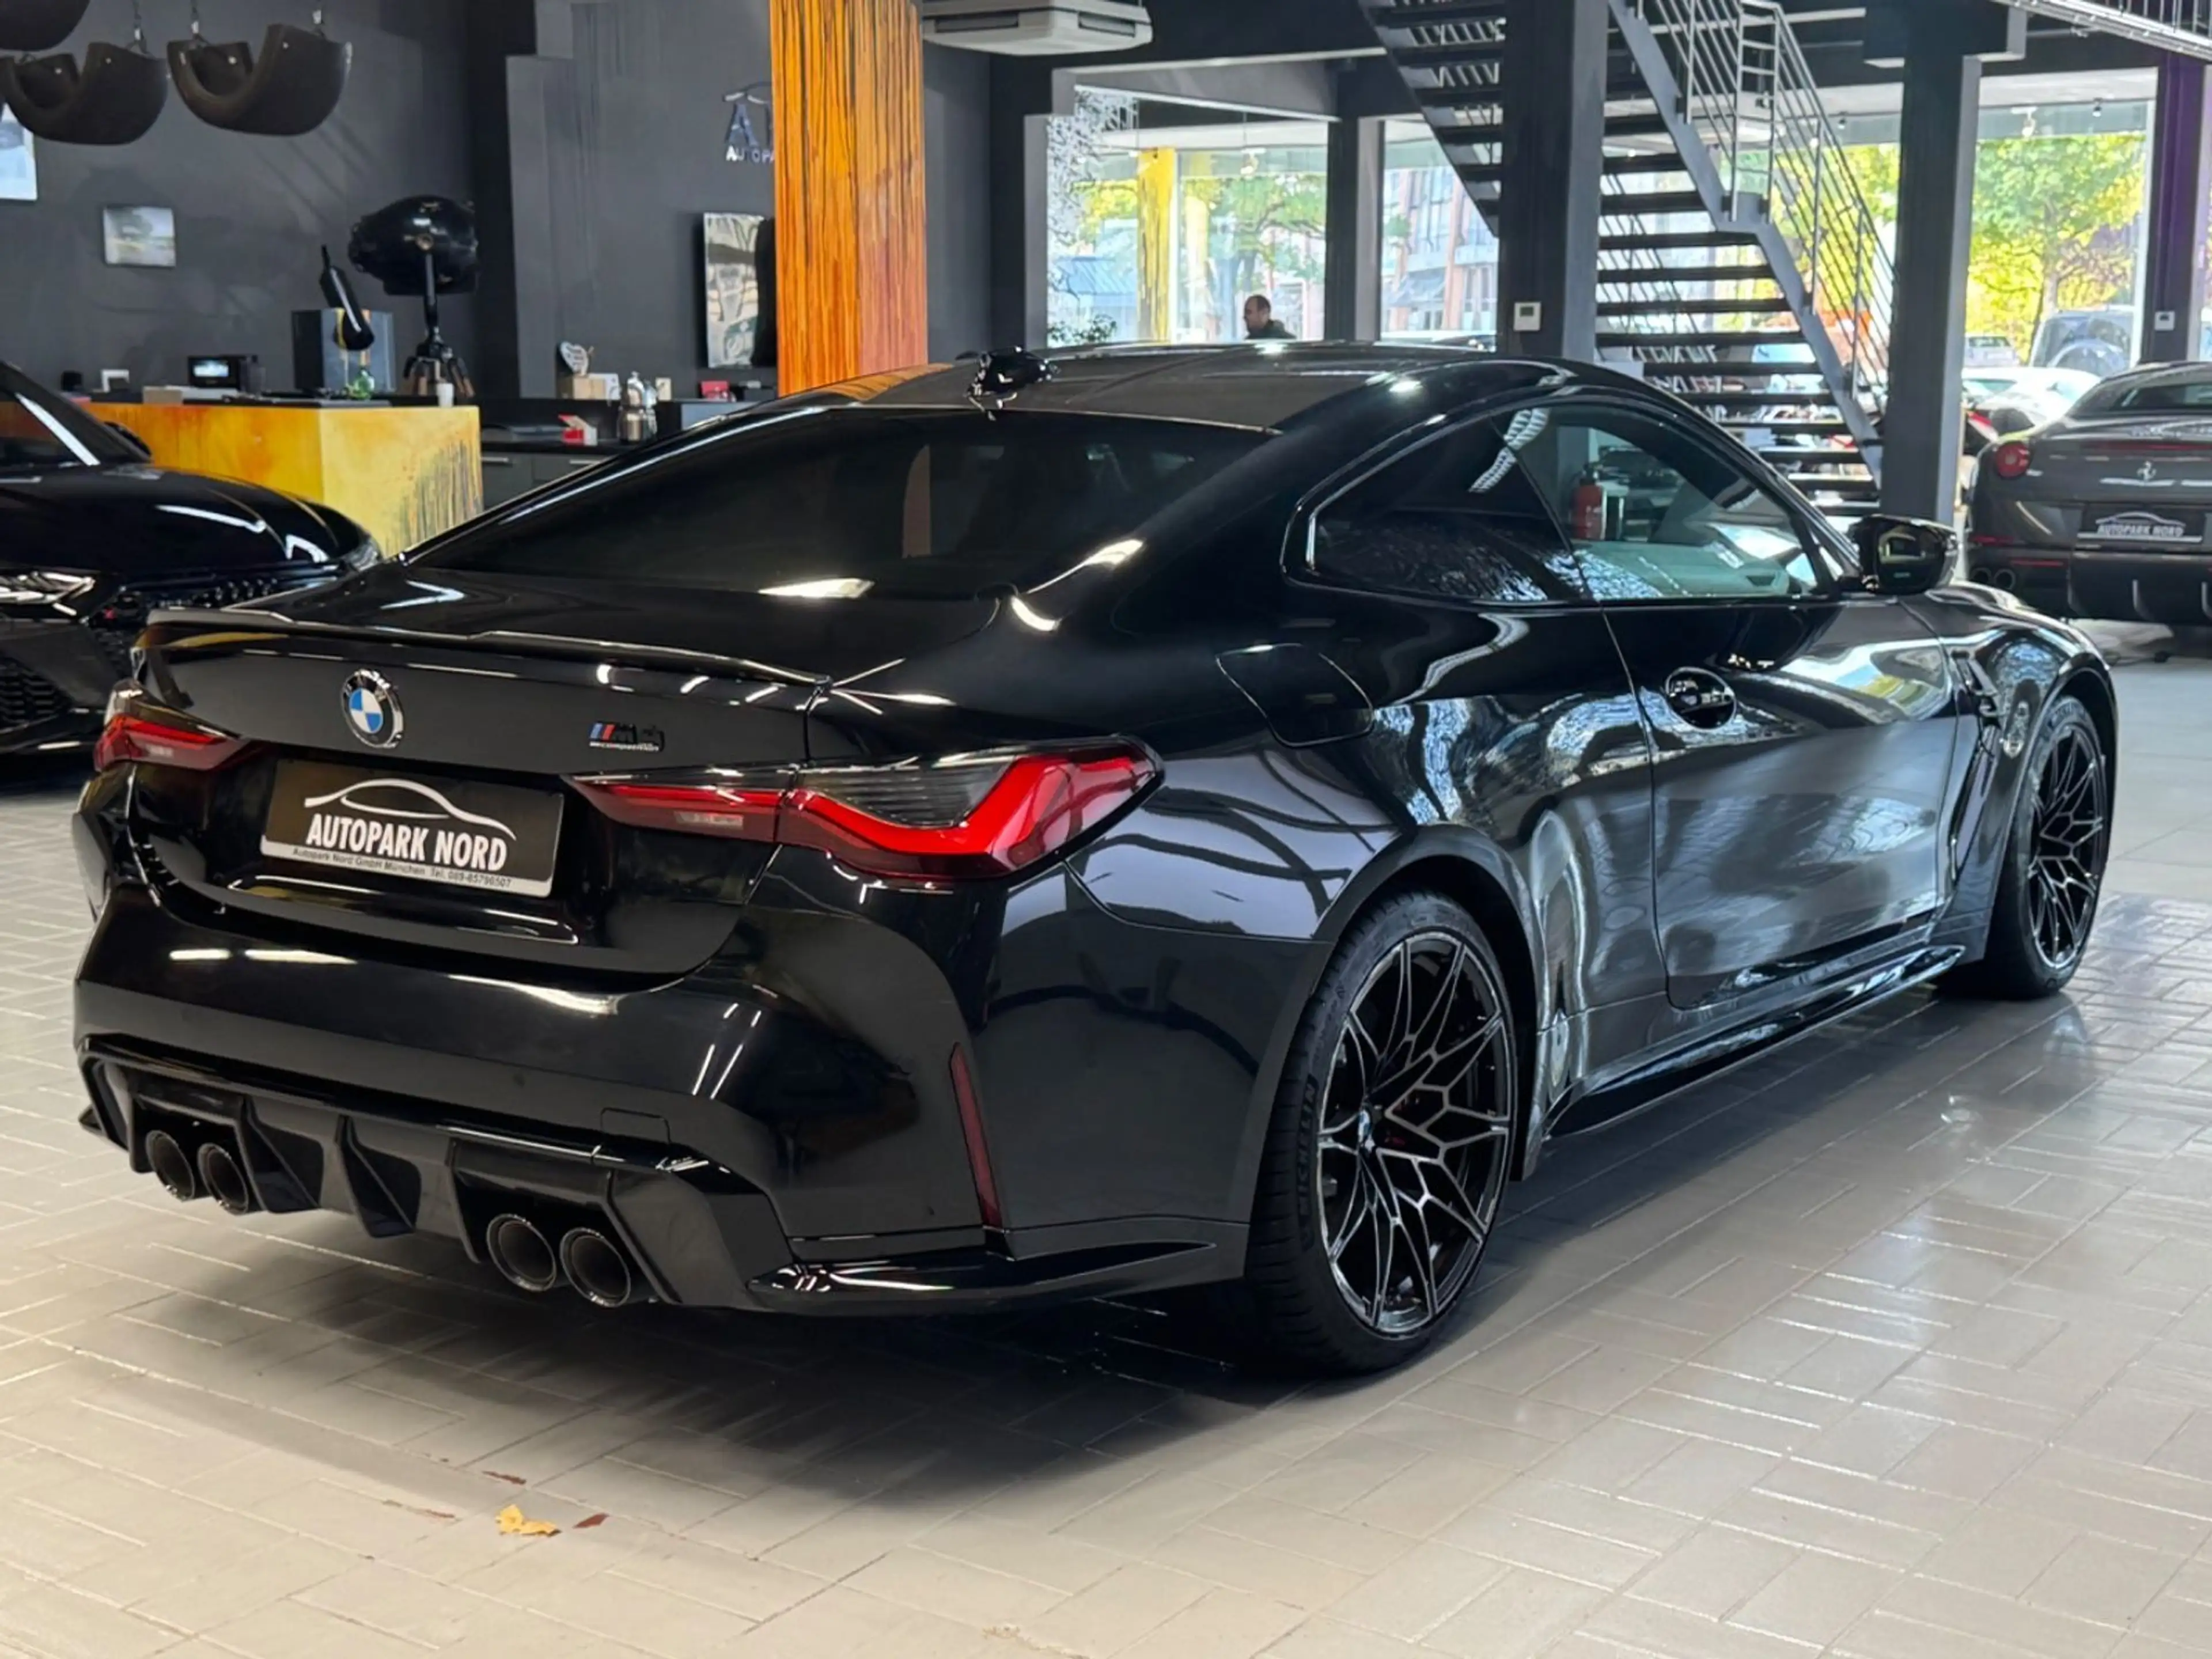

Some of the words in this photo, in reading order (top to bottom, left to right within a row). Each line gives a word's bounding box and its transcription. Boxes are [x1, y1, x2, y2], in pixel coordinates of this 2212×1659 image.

[293, 847, 331, 861] Autopark
[332, 852, 354, 864] Nord
[355, 857, 382, 869] GmbH
[305, 813, 429, 861] AUTOPARK
[434, 830, 507, 871] NORD
[1298, 1083, 1315, 1215] MICHELIN
